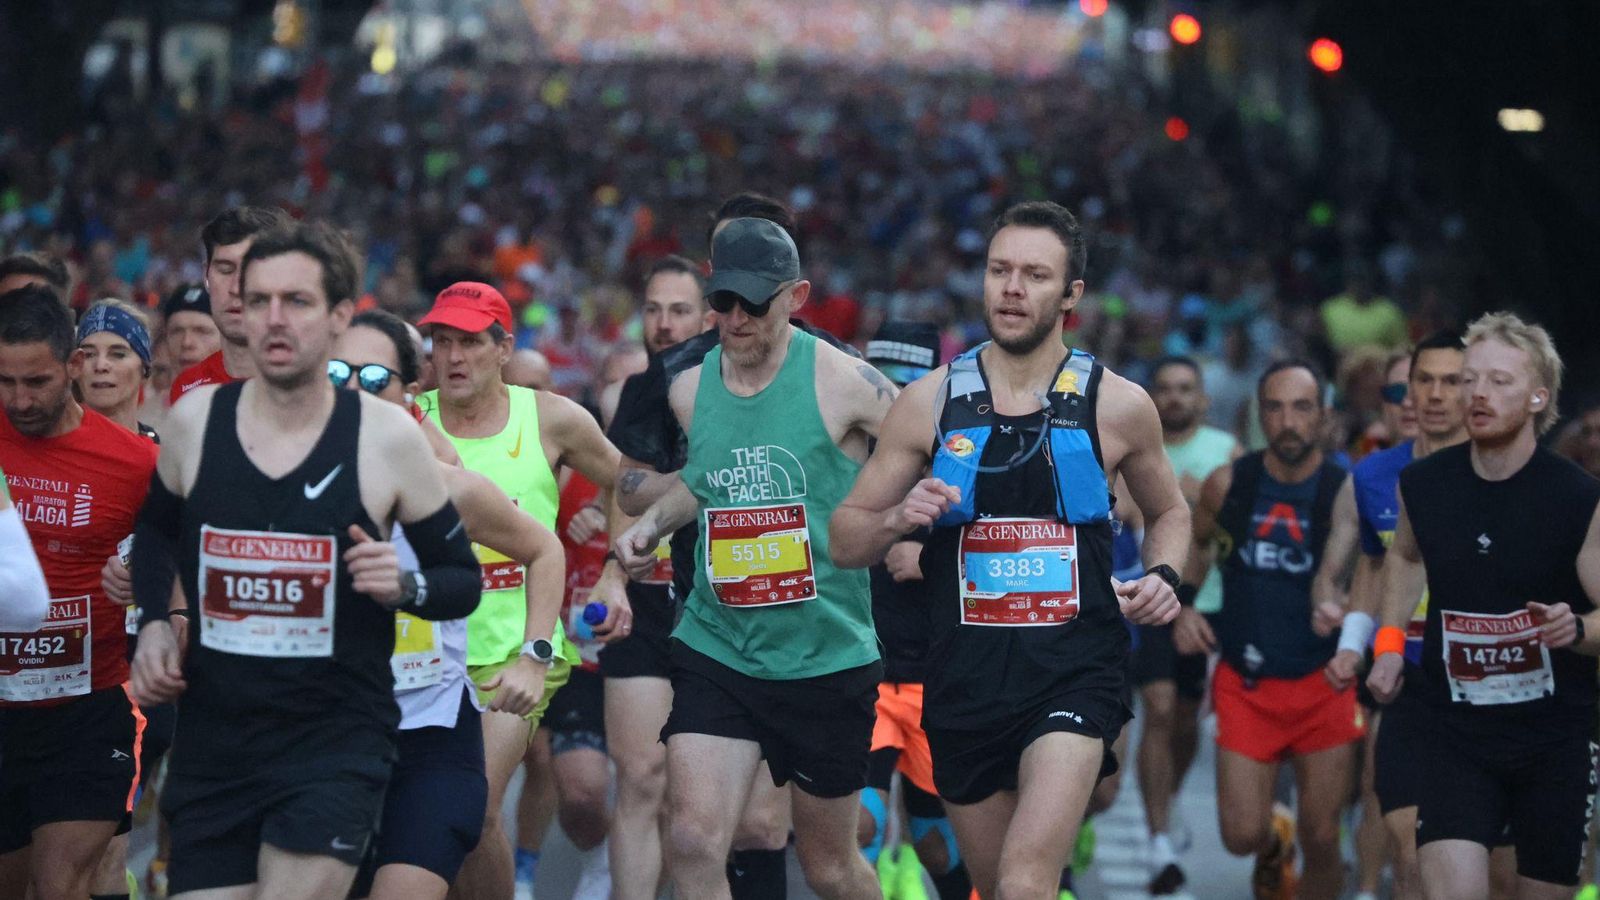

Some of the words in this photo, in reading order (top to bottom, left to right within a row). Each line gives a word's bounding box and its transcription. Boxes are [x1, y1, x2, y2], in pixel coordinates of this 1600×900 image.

[1050, 418, 1078, 427] EVADICT
[731, 445, 767, 466] THE
[8, 474, 69, 493] ENERALI
[706, 465, 769, 488] NORTH
[728, 482, 772, 503] FACE
[17, 498, 67, 527] ÁLAGA
[730, 509, 798, 527] GENERALI
[988, 524, 1066, 540] GENERALI
[231, 538, 324, 561] GENERALI
[731, 542, 781, 562] 5515
[988, 558, 1045, 577] 3383
[223, 576, 304, 603] 10516
[779, 578, 798, 587] 42K
[47, 603, 80, 619] RALI
[1040, 599, 1061, 608] 42K
[1465, 614, 1533, 633] GENERALI
[0, 636, 66, 656] 17452
[1462, 646, 1526, 664] 14742
[18, 657, 45, 665] OVIDIU
[402, 661, 423, 670] 21K
[54, 673, 72, 681] 21K
